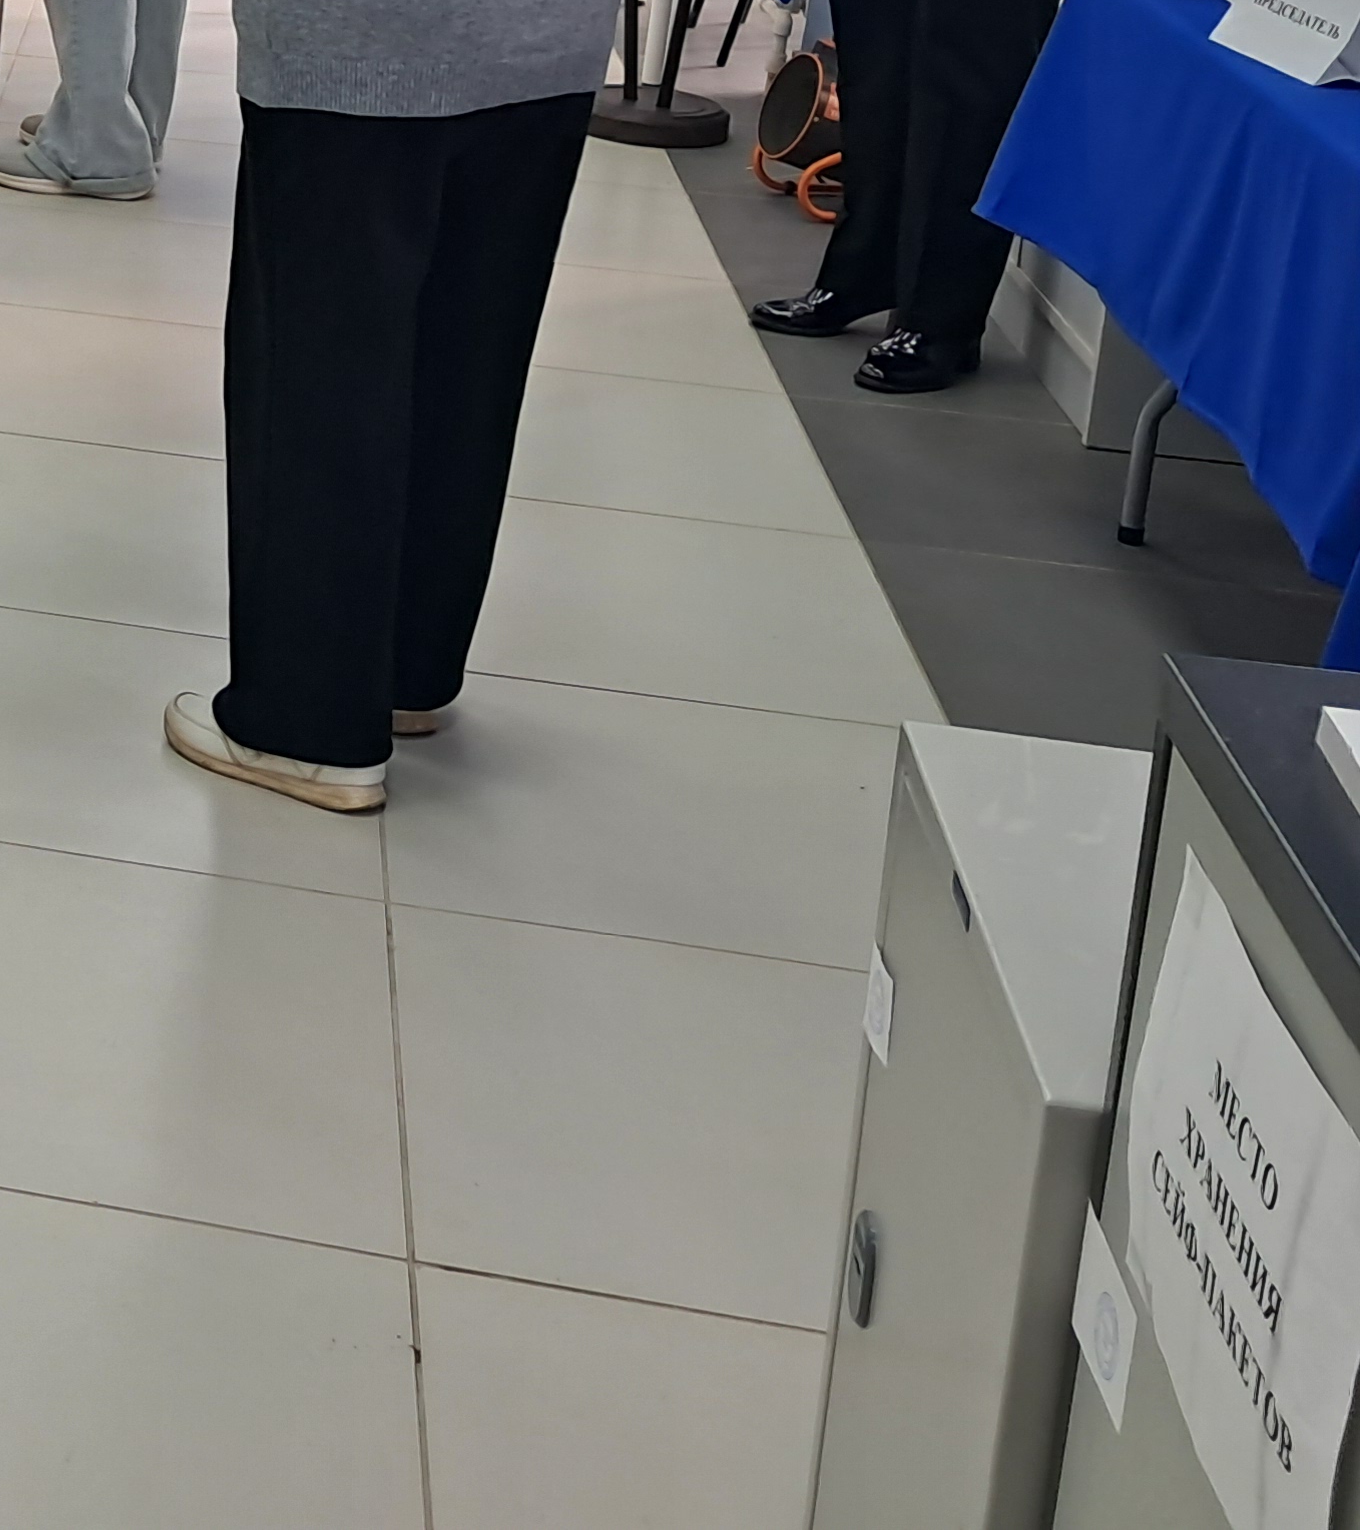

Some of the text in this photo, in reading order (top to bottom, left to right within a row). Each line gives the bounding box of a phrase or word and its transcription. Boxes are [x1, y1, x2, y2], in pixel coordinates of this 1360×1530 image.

[1180, 1105, 1283, 1336] ХРАНЕНИЯ
[1208, 1058, 1279, 1211] МЕСТО
[1151, 1149, 1294, 1473] СЕЙФ-ПАКЕТОВ
